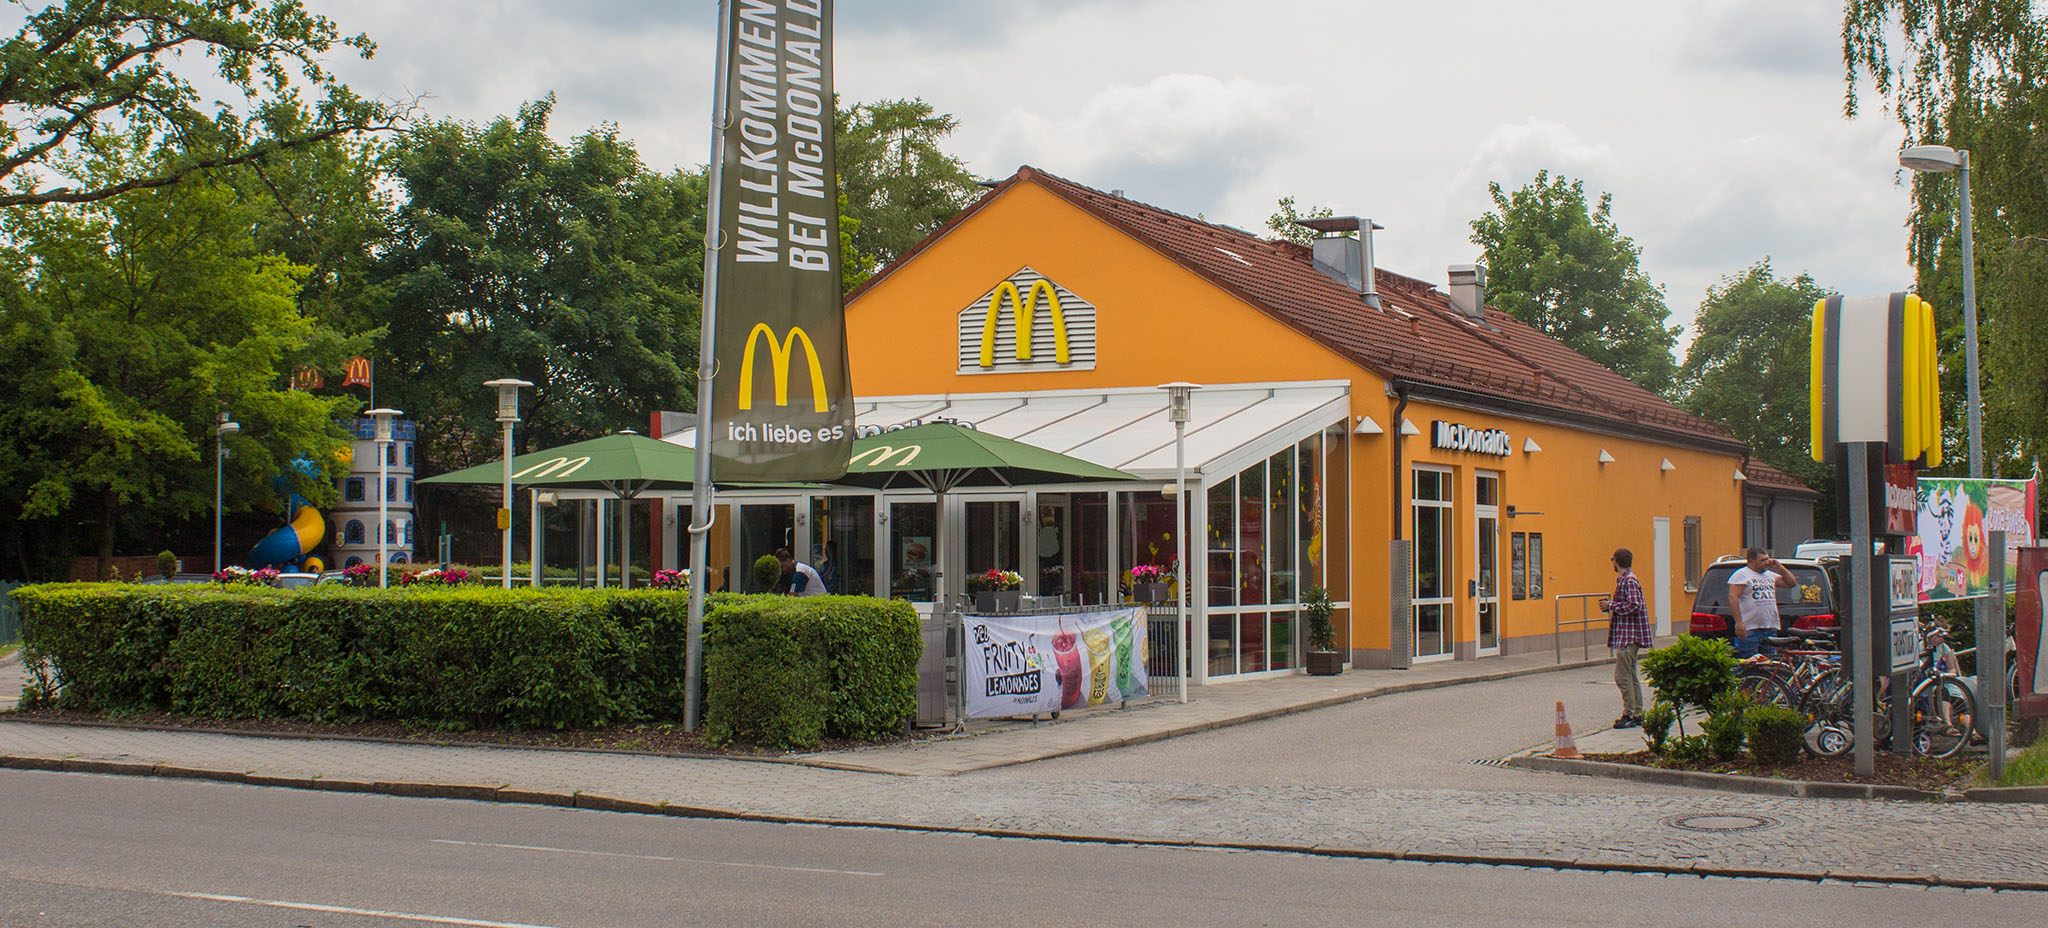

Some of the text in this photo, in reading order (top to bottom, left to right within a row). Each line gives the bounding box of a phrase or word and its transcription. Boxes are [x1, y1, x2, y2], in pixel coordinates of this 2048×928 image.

[735, 0, 779, 263] WILLKOMMEN
[788, 211, 830, 272] BEI
[728, 421, 758, 441] ich
[762, 423, 812, 444] liebe
[1434, 420, 1512, 456] McDonald's
[988, 673, 1040, 695] LEMONADES
